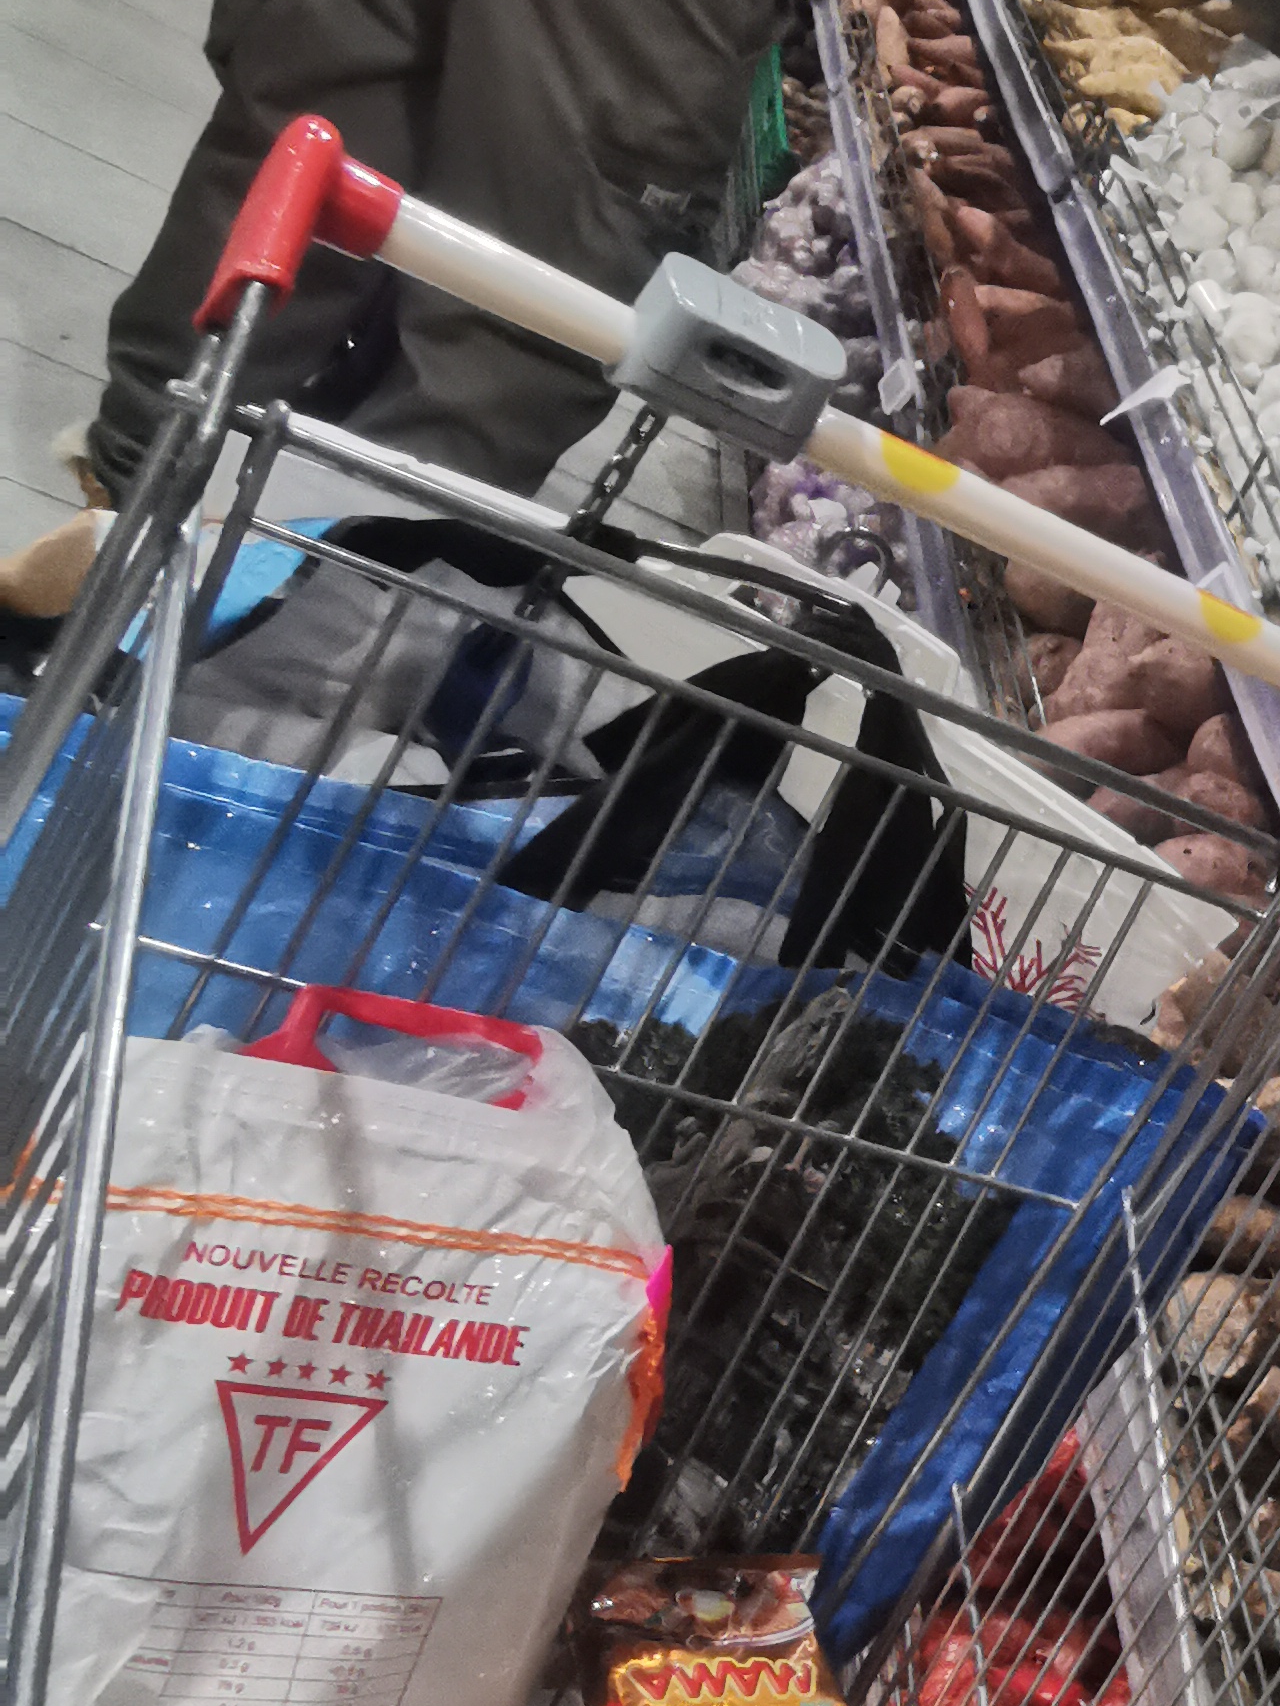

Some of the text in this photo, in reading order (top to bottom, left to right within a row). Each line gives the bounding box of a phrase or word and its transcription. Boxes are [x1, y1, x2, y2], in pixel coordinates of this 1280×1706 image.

[183, 1241, 497, 1306] NOUVELLE RECOLTE
[115, 1269, 530, 1366] PRODUIT DE THAILANDE
[249, 1414, 332, 1474] TF
[630, 1659, 812, 1701] MAMA
